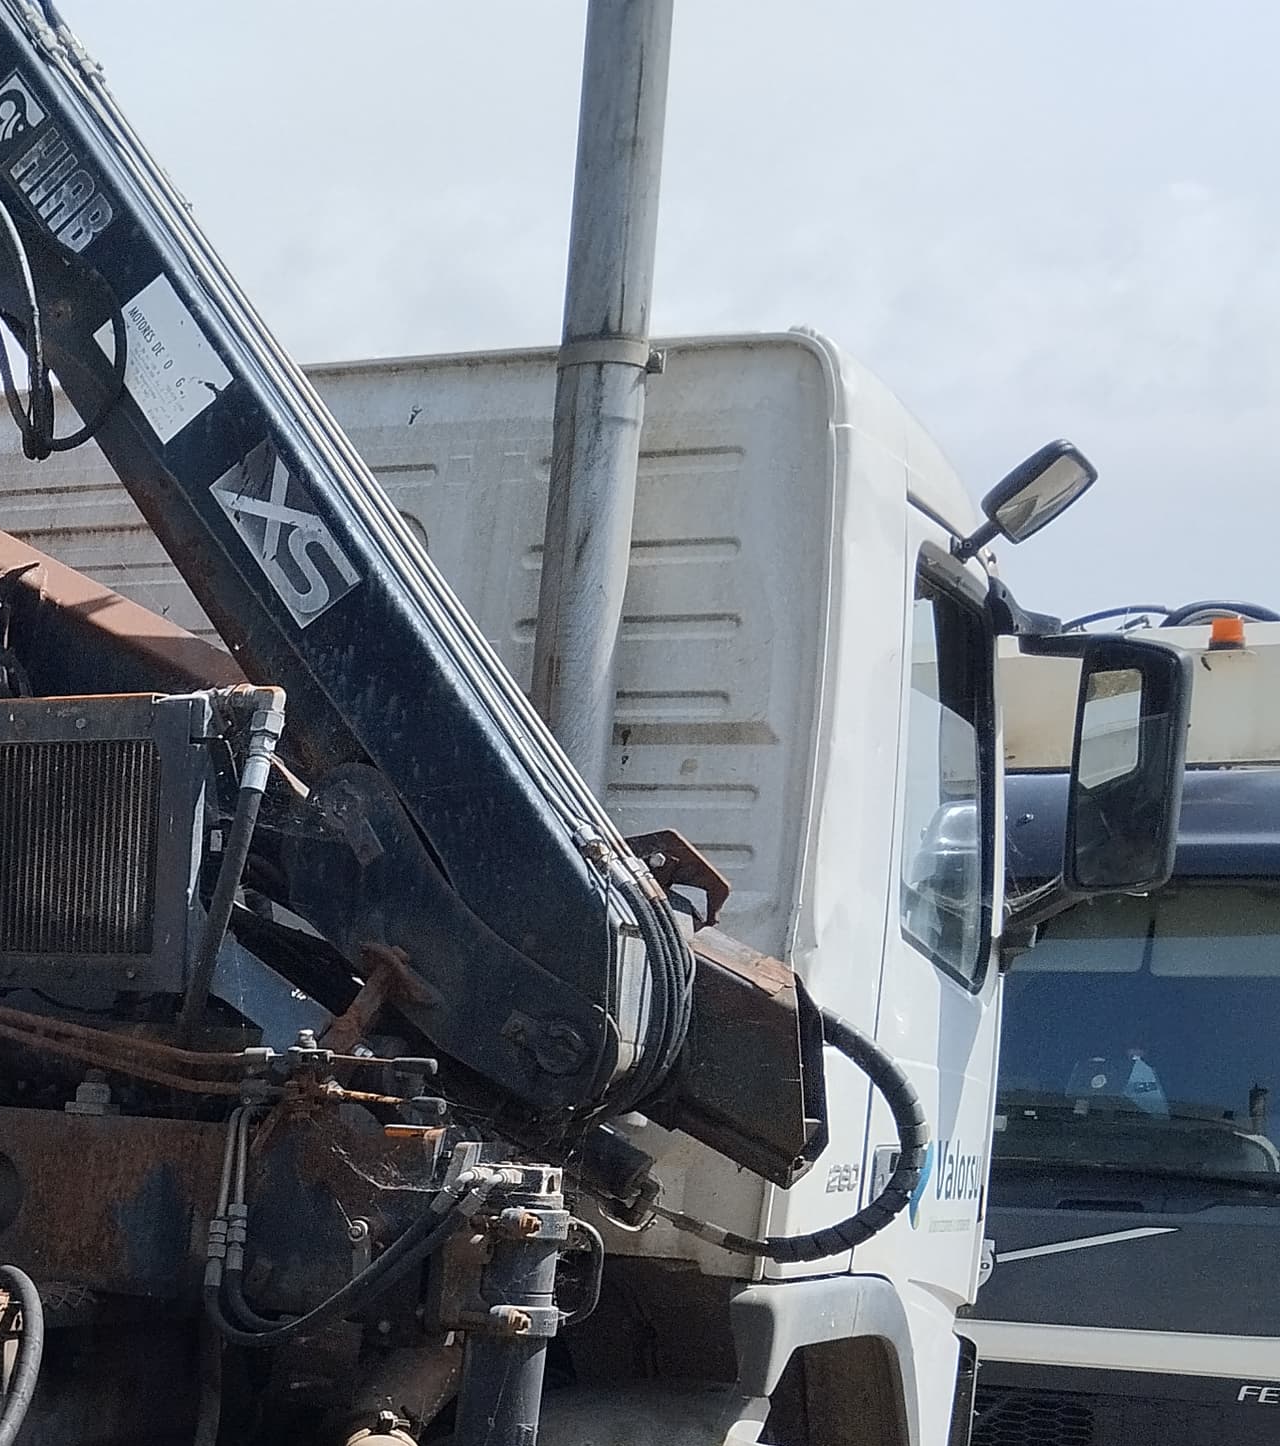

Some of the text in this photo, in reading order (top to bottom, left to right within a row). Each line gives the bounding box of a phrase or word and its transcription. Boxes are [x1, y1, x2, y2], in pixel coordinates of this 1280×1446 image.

[10, 126, 113, 254] HIAB
[127, 305, 156, 344] MOTORES
[151, 341, 166, 356] DE
[211, 454, 362, 614] XS
